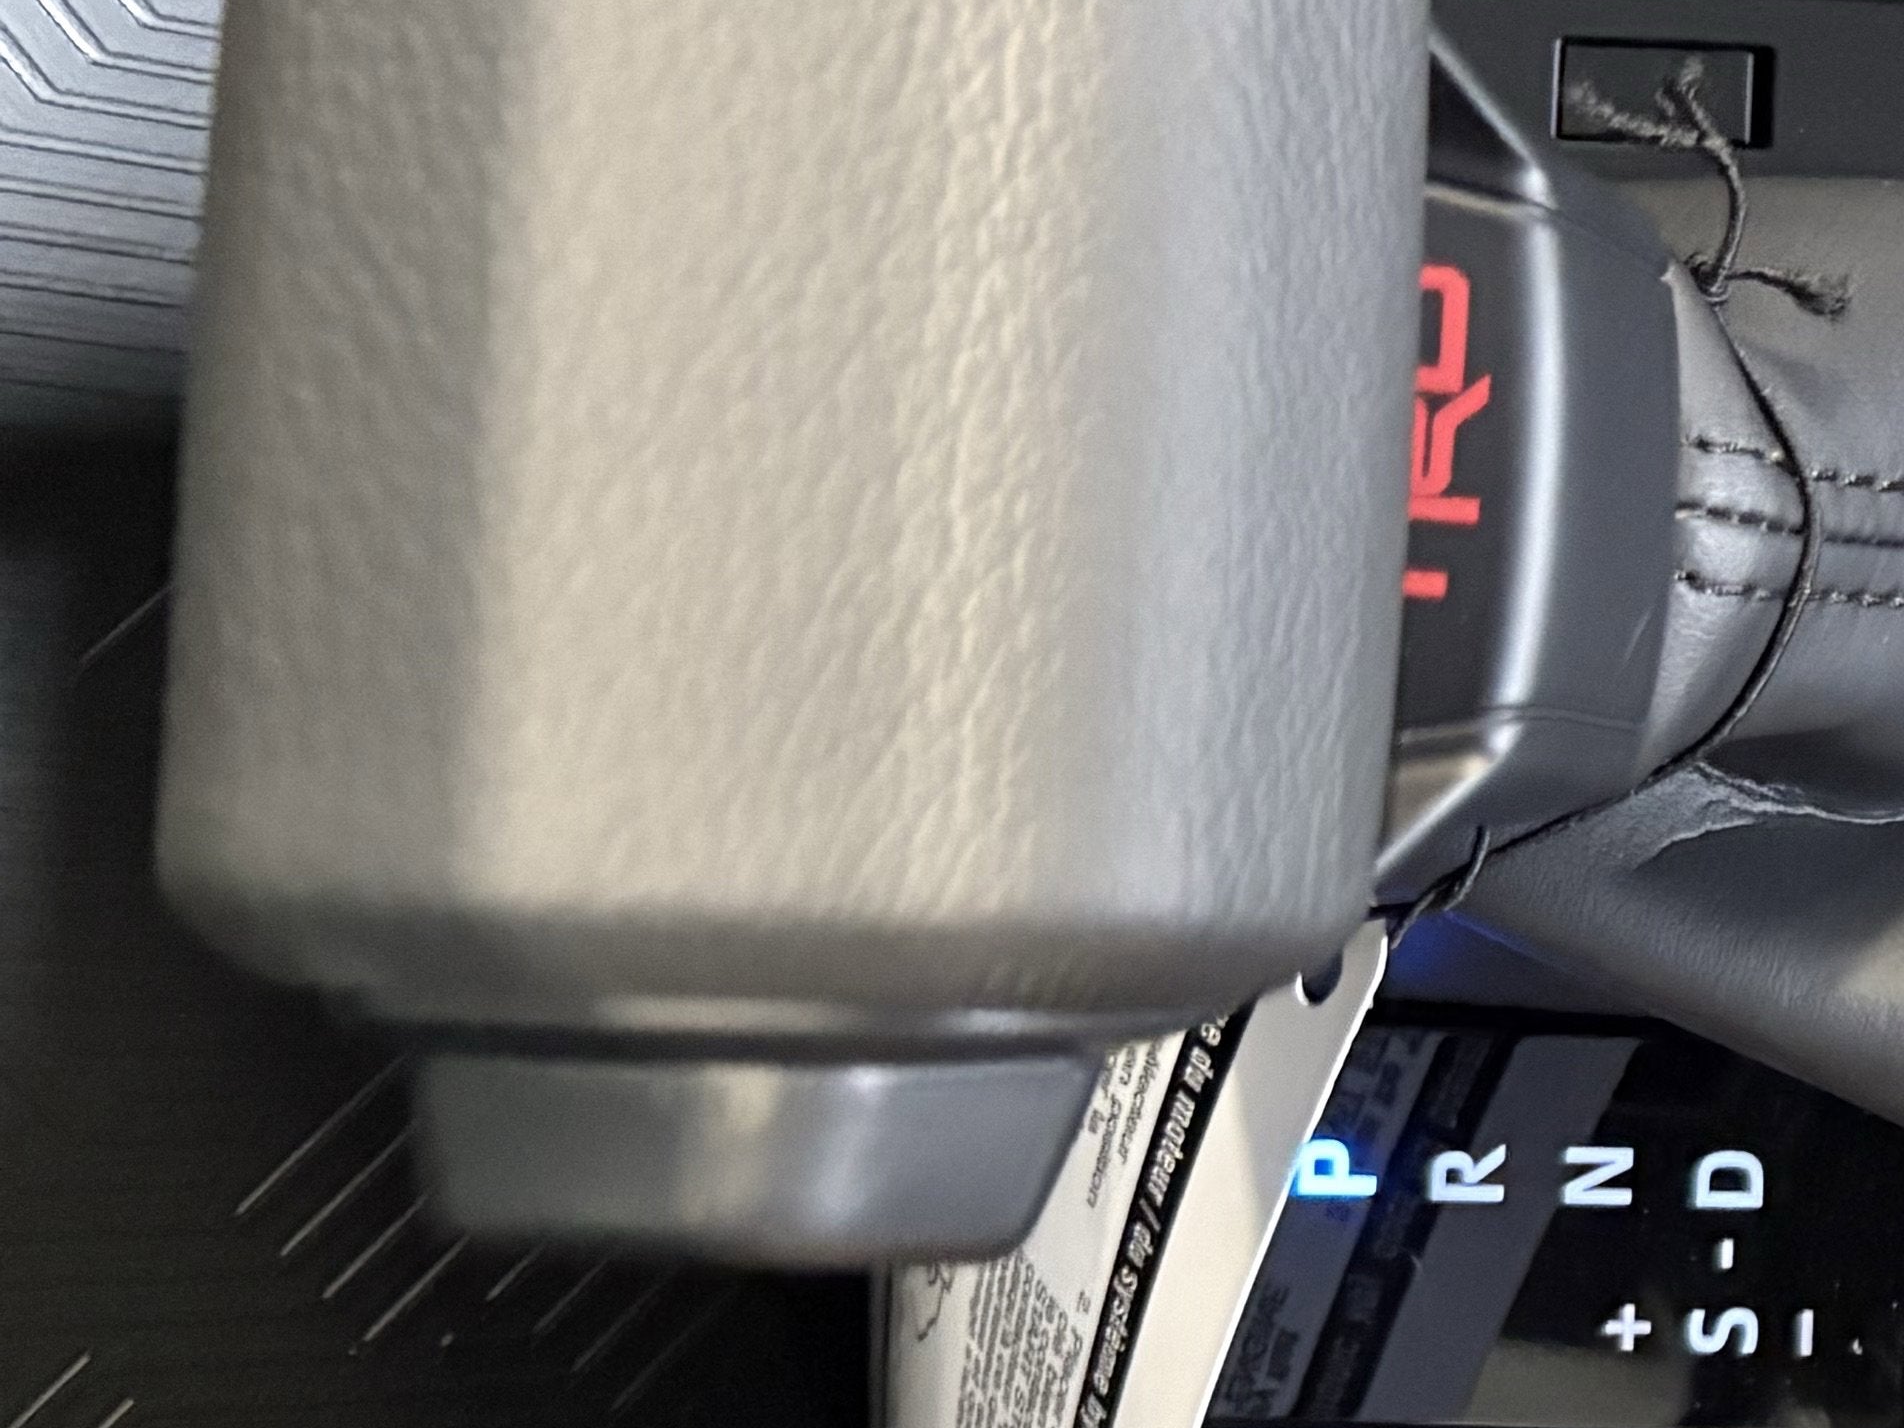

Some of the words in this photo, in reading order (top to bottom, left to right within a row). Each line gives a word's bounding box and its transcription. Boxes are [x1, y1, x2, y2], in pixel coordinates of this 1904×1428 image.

[1147, 1090, 1196, 1208] moteur
[1294, 1138, 1377, 1197] P
[1429, 1144, 1507, 1203] R
[1562, 1146, 1634, 1206] N
[1694, 1150, 1764, 1210] D
[1687, 1307, 1759, 1355] S
